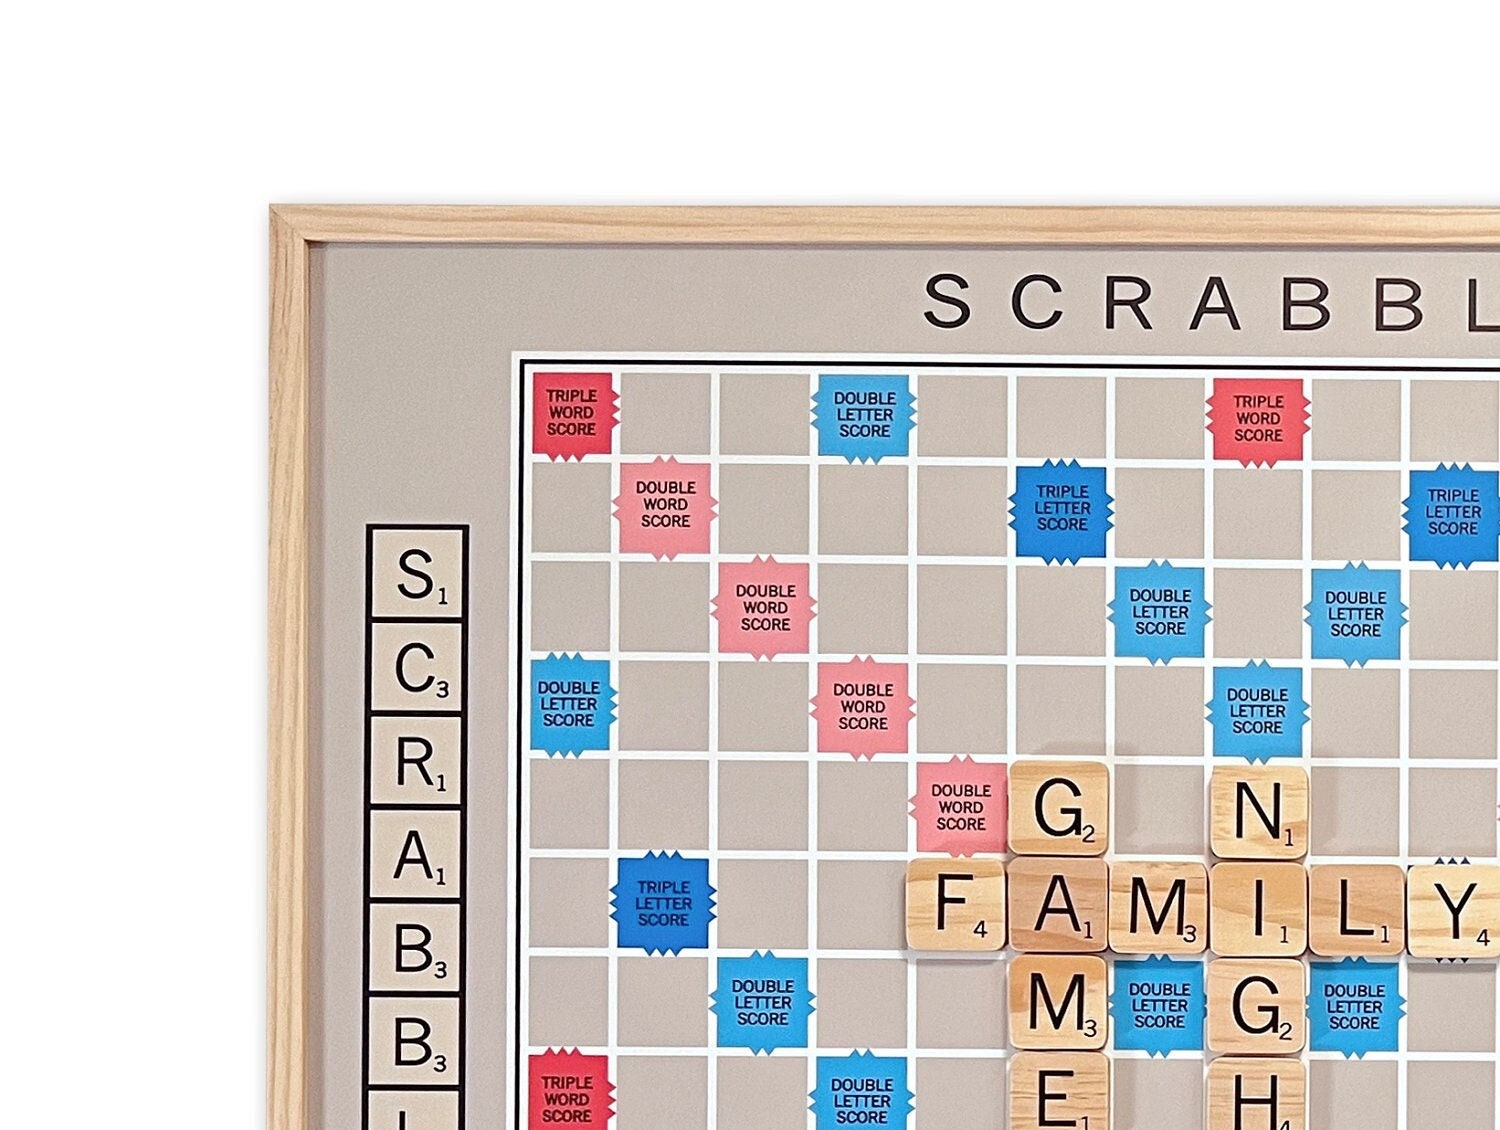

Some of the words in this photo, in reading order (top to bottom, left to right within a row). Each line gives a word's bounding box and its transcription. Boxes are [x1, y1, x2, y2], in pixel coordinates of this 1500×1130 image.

[546, 389, 597, 403] TRIPLE
[834, 391, 897, 406] DOUBLE
[549, 405, 594, 419] WORD
[837, 407, 894, 422] LETTER
[547, 422, 596, 436] SCORE
[839, 424, 891, 438] SCORE
[636, 480, 696, 495] DOUBLE
[1430, 488, 1480, 503] TRIPLE
[643, 497, 689, 511] WORD
[1426, 505, 1482, 519] LETTER
[641, 514, 691, 528] SCORE
[1428, 521, 1478, 535] SCORE
[736, 584, 797, 598] DOUBLE
[1325, 590, 1387, 605] DOUBLE
[743, 601, 789, 614] WORD
[1328, 607, 1384, 621] LETTER
[741, 617, 791, 632] SCORE
[1330, 623, 1381, 638] SCORE
[538, 681, 601, 695] DOUBLE
[540, 696, 597, 711] LETTER
[543, 713, 594, 727] SCORE
[732, 979, 795, 994] DOUBLE
[1324, 984, 1386, 998] DOUBLE
[735, 995, 792, 1010] LETTER
[1327, 1000, 1383, 1014] LETTER
[737, 1012, 789, 1026] SCORE
[1329, 1016, 1380, 1030] SCORE
[542, 1076, 593, 1090] TRIPLE
[544, 1092, 590, 1106] WORD
[542, 1109, 592, 1123] SCORE
